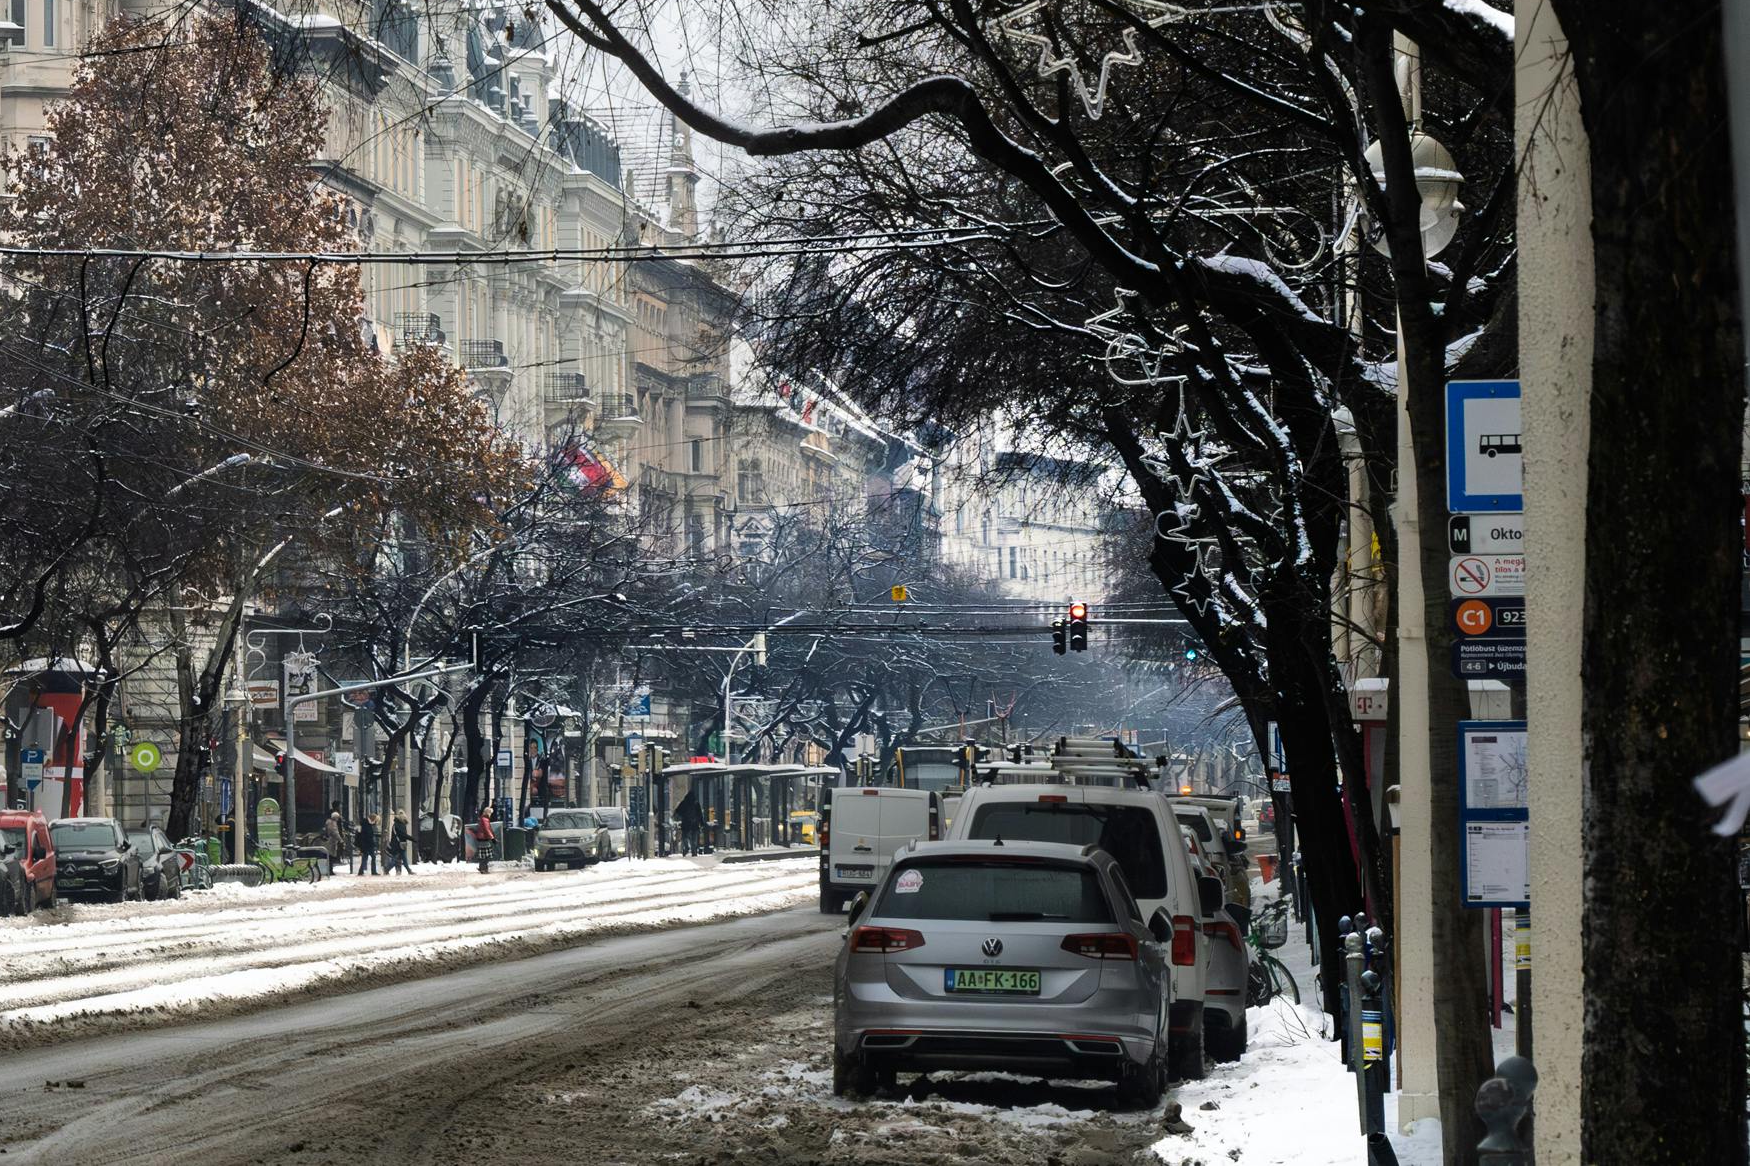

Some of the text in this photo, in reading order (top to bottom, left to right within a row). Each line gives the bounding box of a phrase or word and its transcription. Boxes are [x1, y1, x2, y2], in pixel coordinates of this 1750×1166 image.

[1453, 528, 1523, 541] M Okto
[1462, 609, 1485, 626] C1
[27, 752, 38, 762] P
